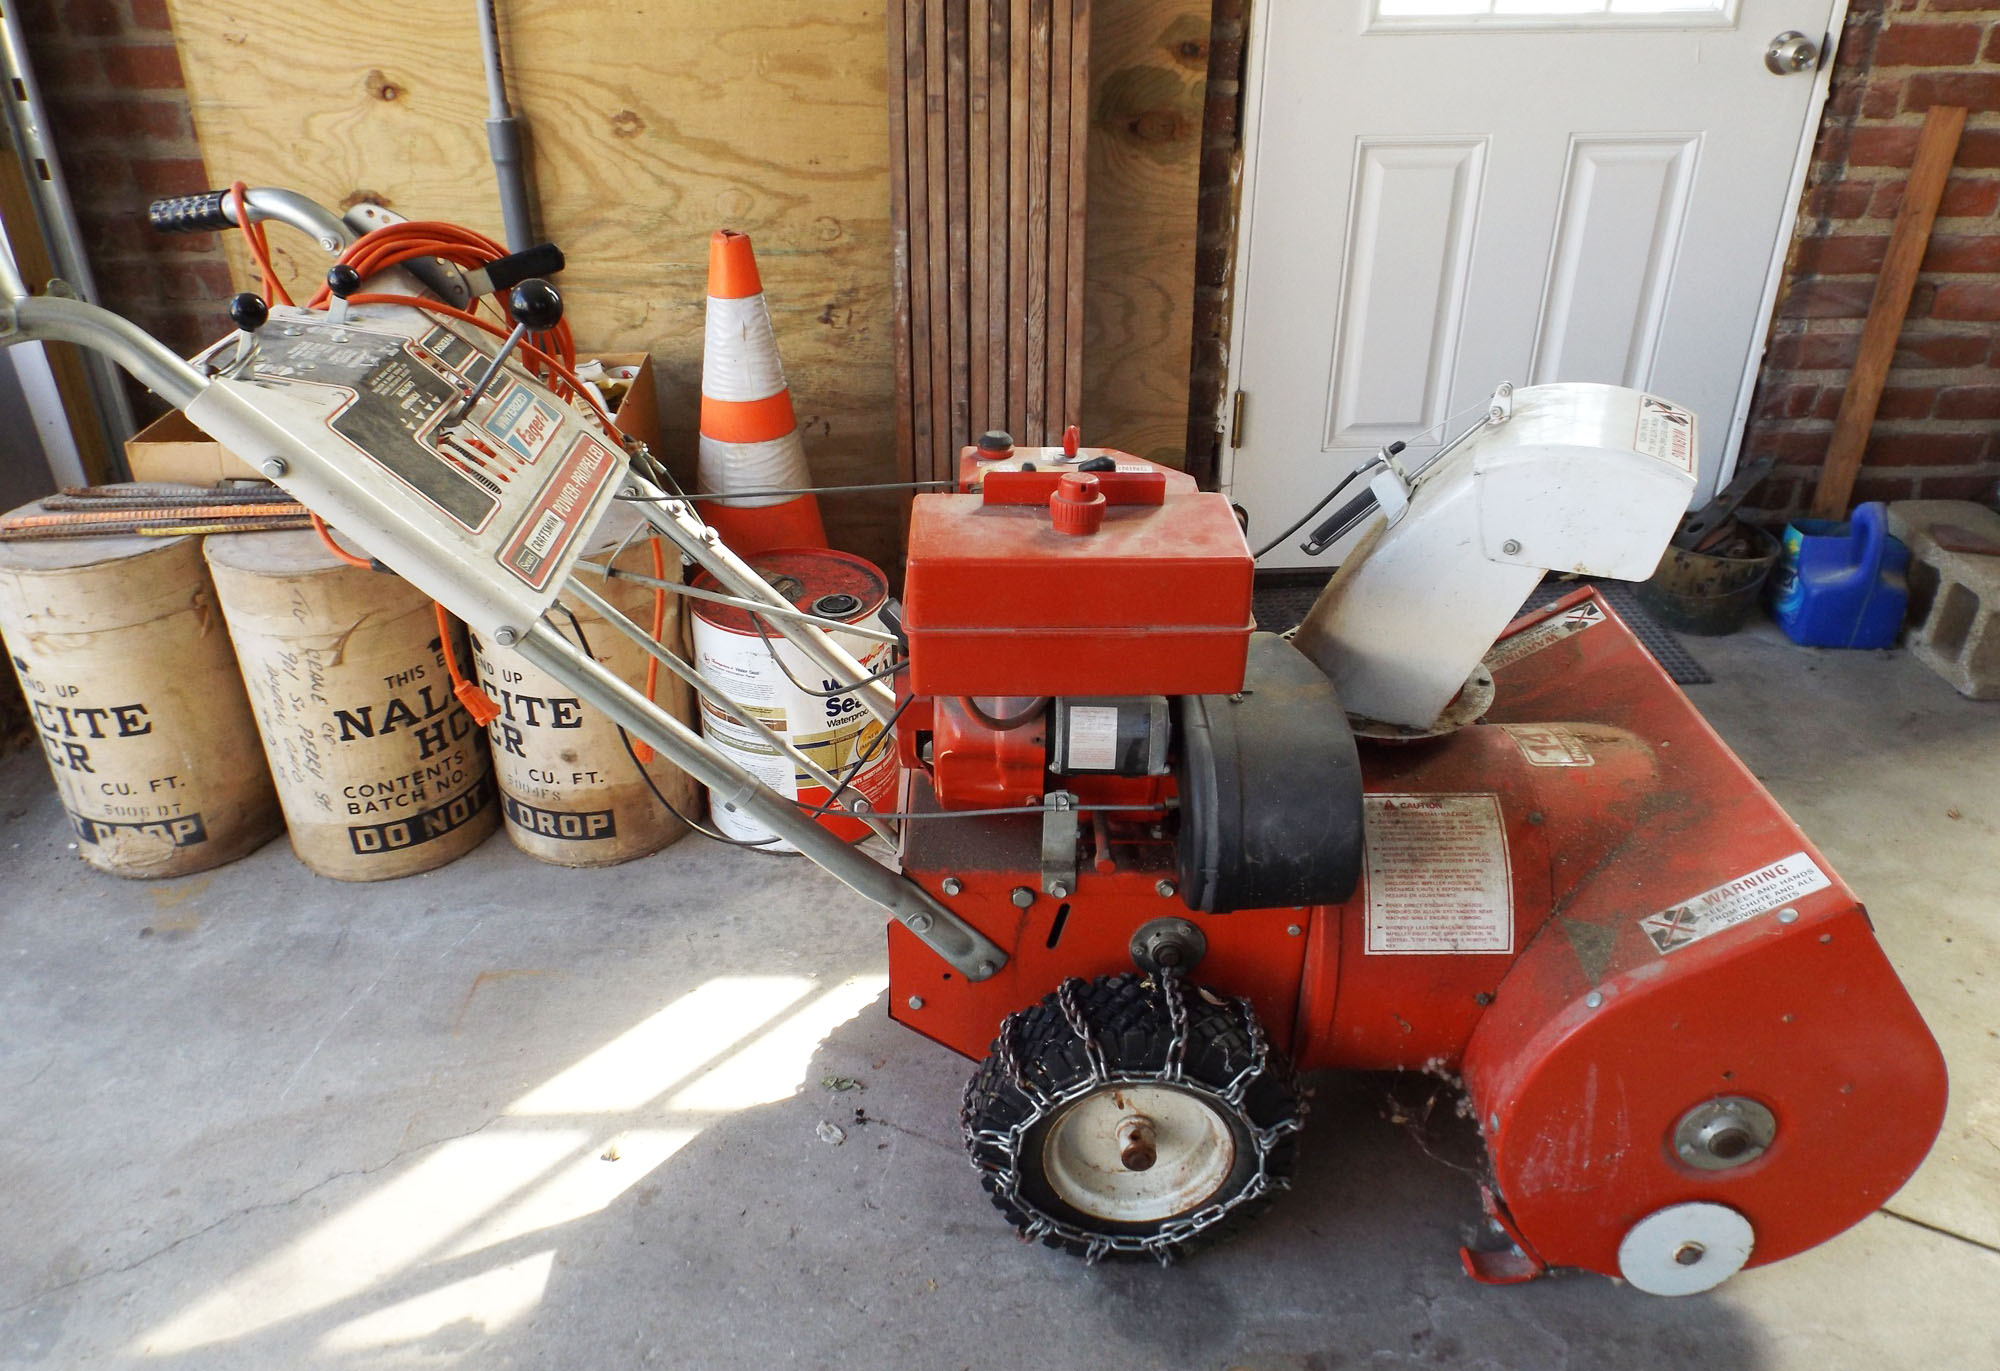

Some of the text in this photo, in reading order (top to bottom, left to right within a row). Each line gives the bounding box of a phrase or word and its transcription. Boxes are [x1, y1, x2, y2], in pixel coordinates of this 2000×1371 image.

[519, 444, 604, 570] Sears CRAFTSMAN POWER-PROPELLED
[1497, 634, 1559, 667] WARNING
[384, 664, 425, 689] THIS
[476, 654, 523, 685] END UP
[56, 685, 79, 697] UP
[299, 724, 323, 780] PERRY
[101, 782, 138, 796] CU.
[149, 776, 186, 793] FT.
[343, 751, 462, 799] CONTENTS
[348, 770, 468, 815] BATCH NO.
[529, 769, 560, 785] CU.
[572, 771, 604, 785] FT.
[355, 822, 412, 851] DO
[422, 786, 482, 838] NOT
[517, 804, 608, 837] DROP
[1702, 864, 1789, 905] WARNING
[1704, 868, 1814, 917] KEEP FEET AND HANDS
[1709, 876, 1815, 923] FROM CHUTE AND ALL
[1727, 890, 1800, 923] MOVING PARTS
